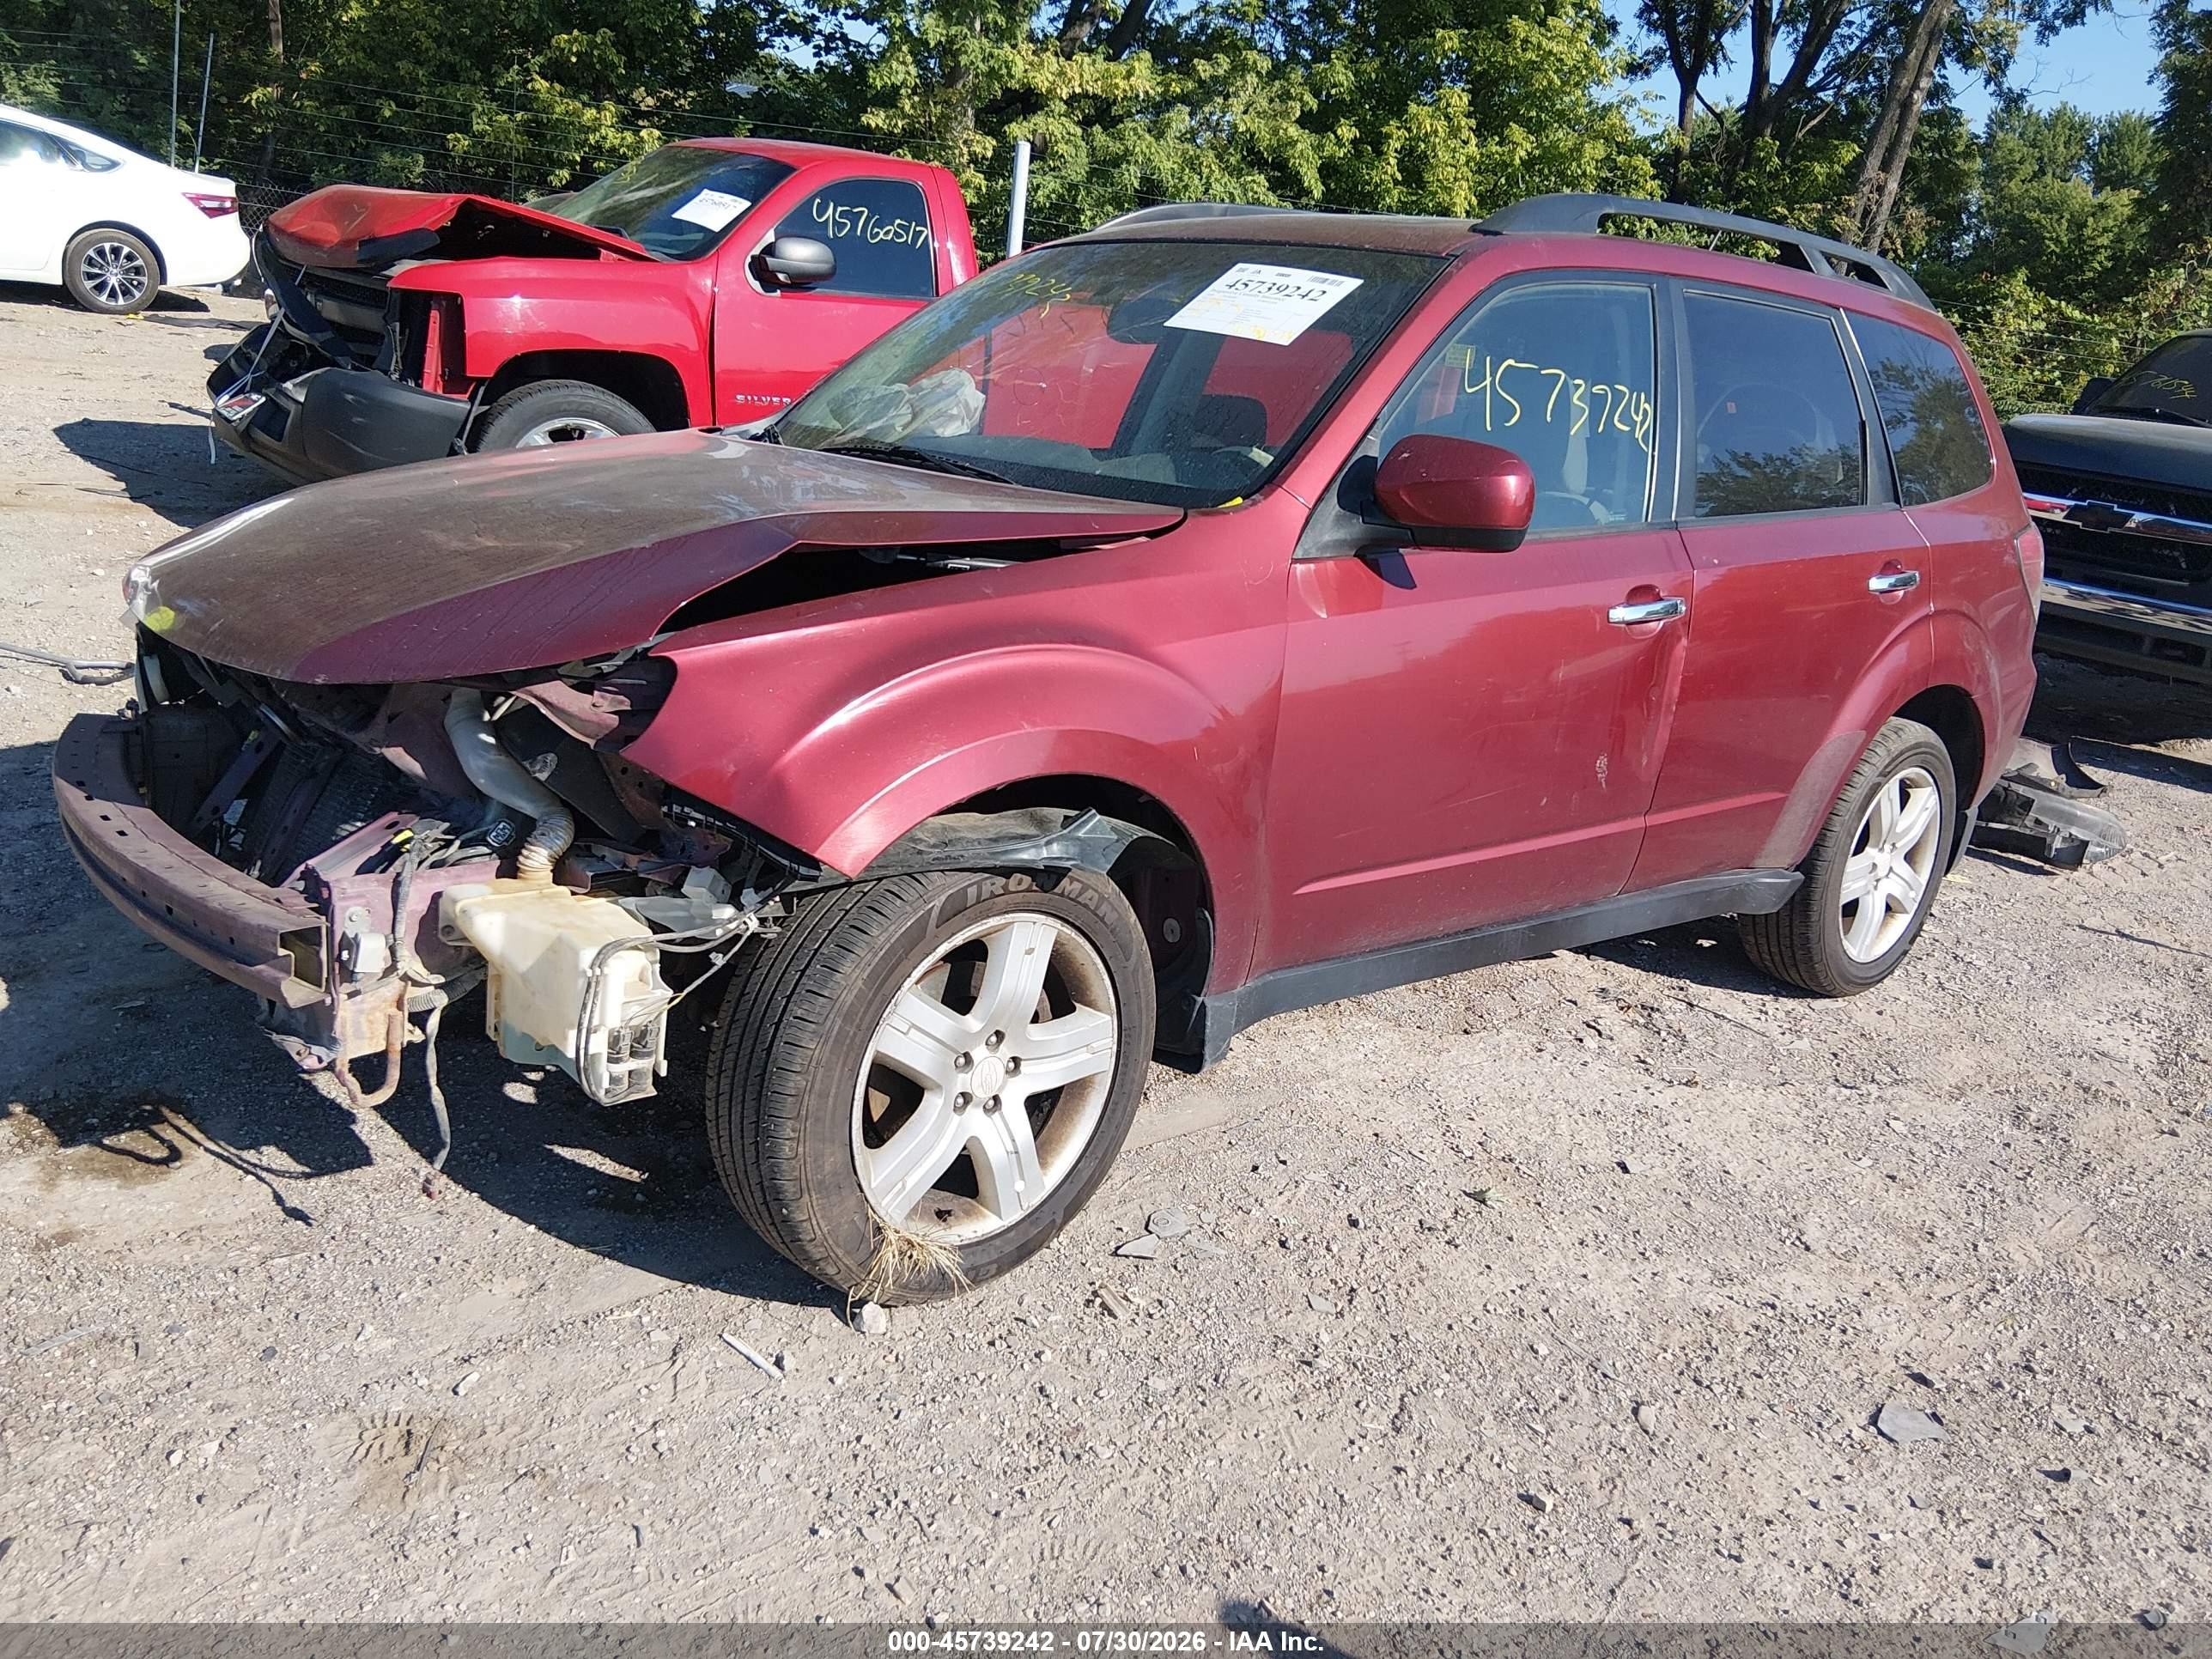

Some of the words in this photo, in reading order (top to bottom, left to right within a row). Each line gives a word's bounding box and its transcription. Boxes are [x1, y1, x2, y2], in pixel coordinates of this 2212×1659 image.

[812, 198, 928, 249] 45760517
[1225, 278, 1328, 301] 45739242
[1465, 348, 1652, 453] 45739242
